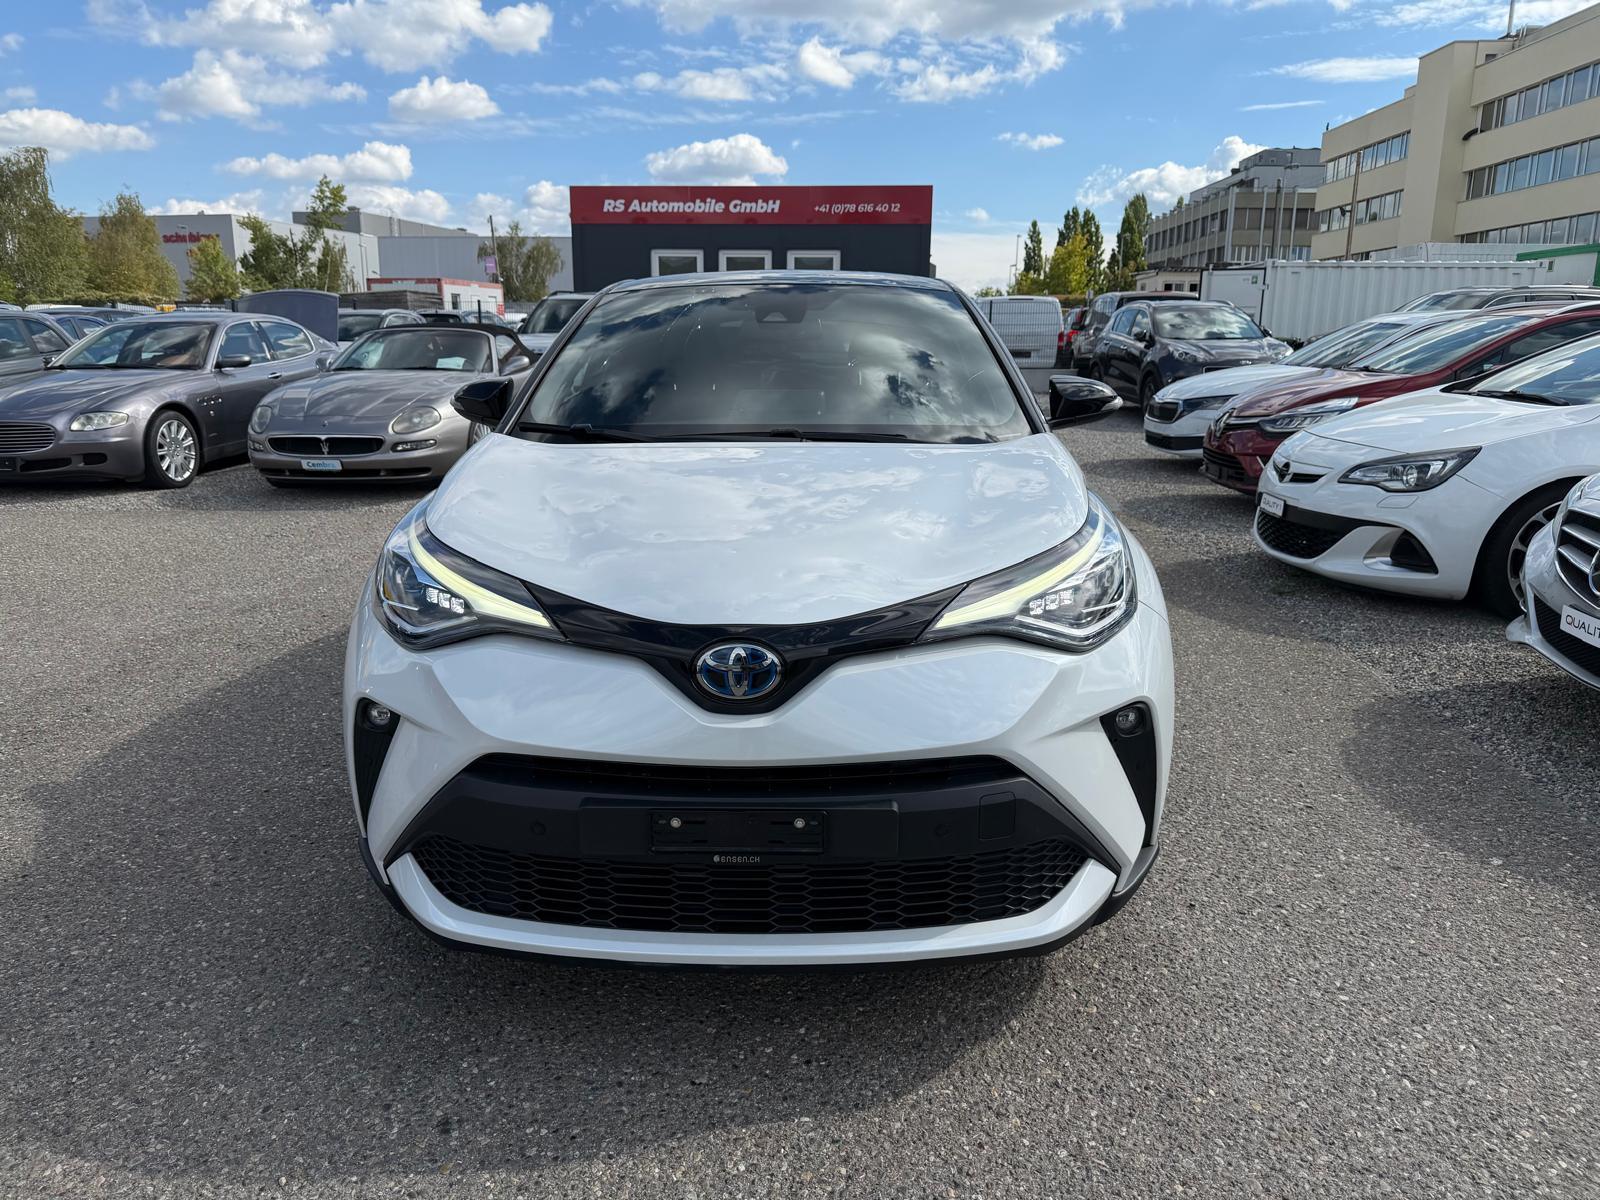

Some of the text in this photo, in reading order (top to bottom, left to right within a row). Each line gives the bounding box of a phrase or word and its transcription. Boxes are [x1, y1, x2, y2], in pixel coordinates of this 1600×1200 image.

[603, 198, 780, 213] RS Automobile GmbH
[814, 203, 901, 214] +41 (0)78 616 40 12
